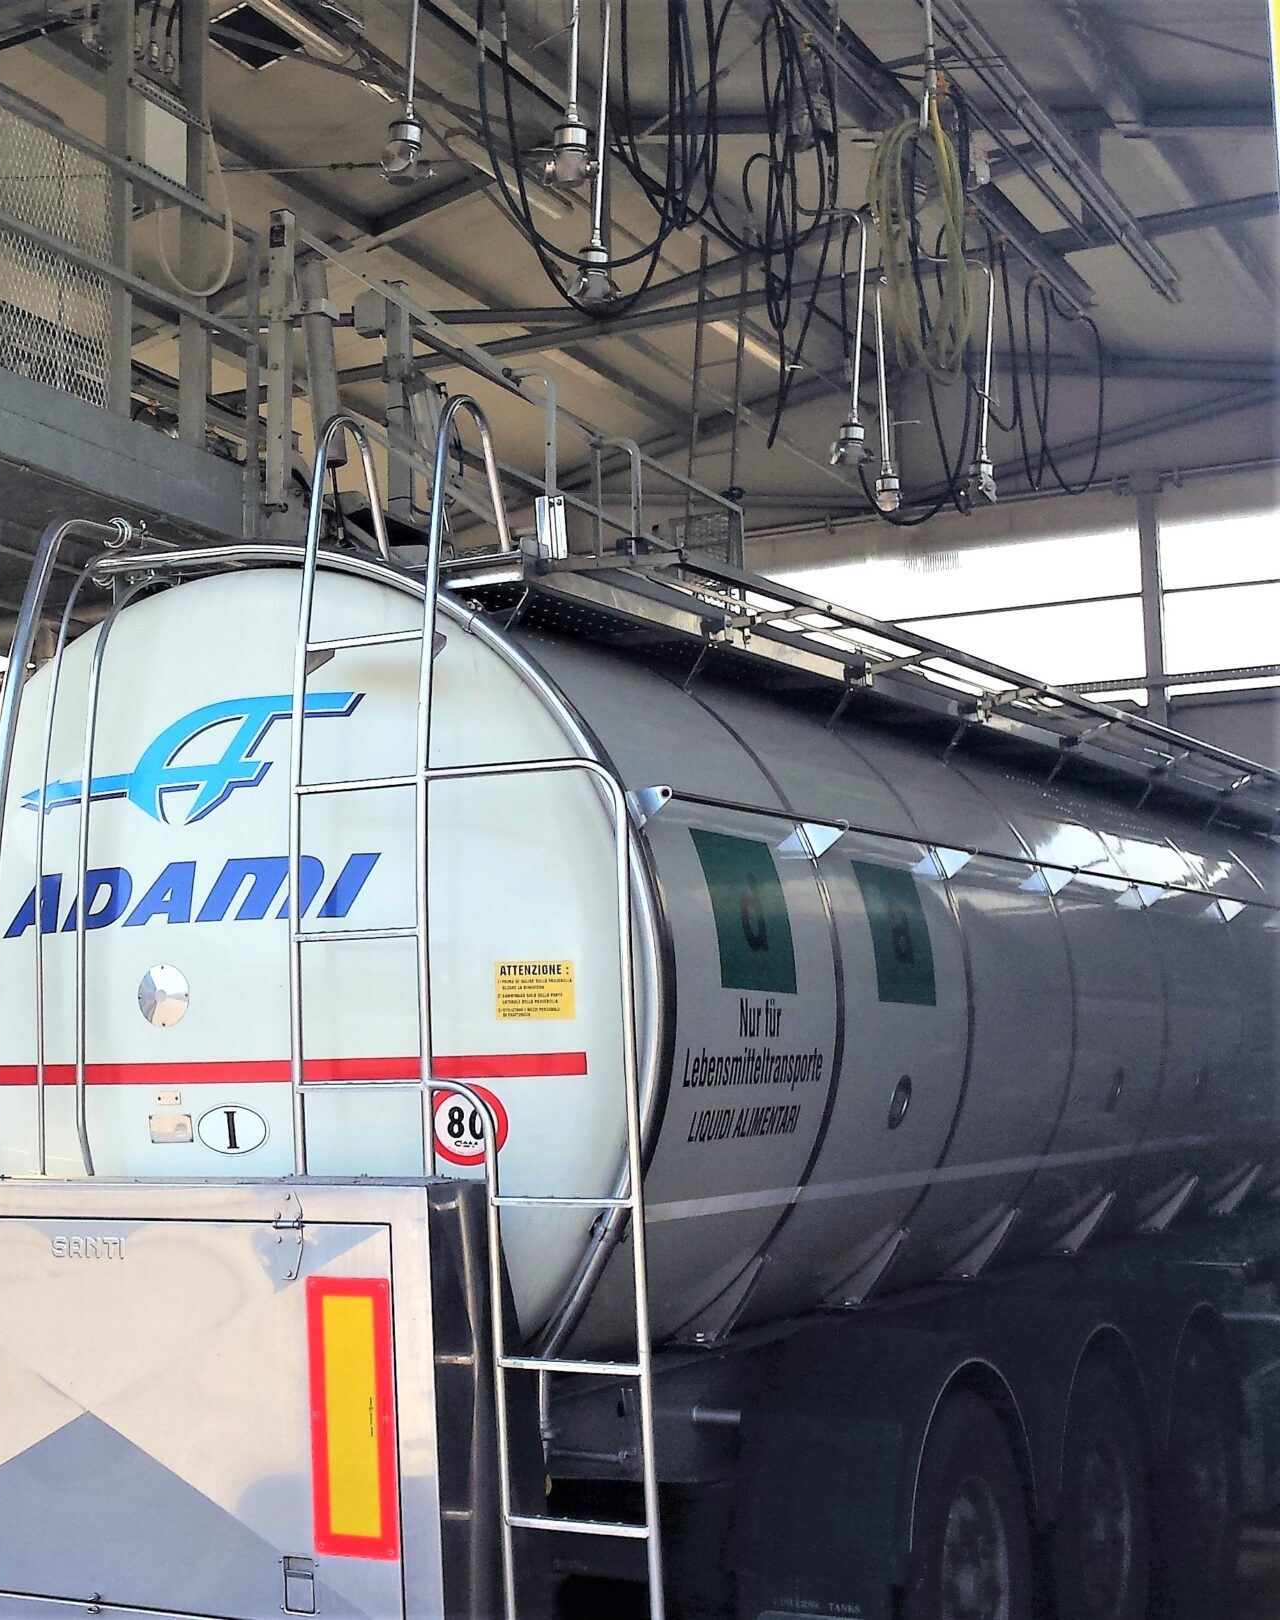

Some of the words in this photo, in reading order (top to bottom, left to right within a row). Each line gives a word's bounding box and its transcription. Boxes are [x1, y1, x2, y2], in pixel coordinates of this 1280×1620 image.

[3, 852, 382, 939] ADAMI
[500, 964, 562, 976] ATTENZIONE
[739, 998, 761, 1037] Nur
[765, 999, 782, 1037] für
[682, 1046, 823, 1091] Lebensmitteltransporte
[224, 1111, 240, 1149] I
[447, 1105, 485, 1140] 80
[687, 1109, 736, 1142] LIQUIDI
[732, 1104, 801, 1138] ALIMENTARI
[52, 1235, 126, 1260] SANTI
